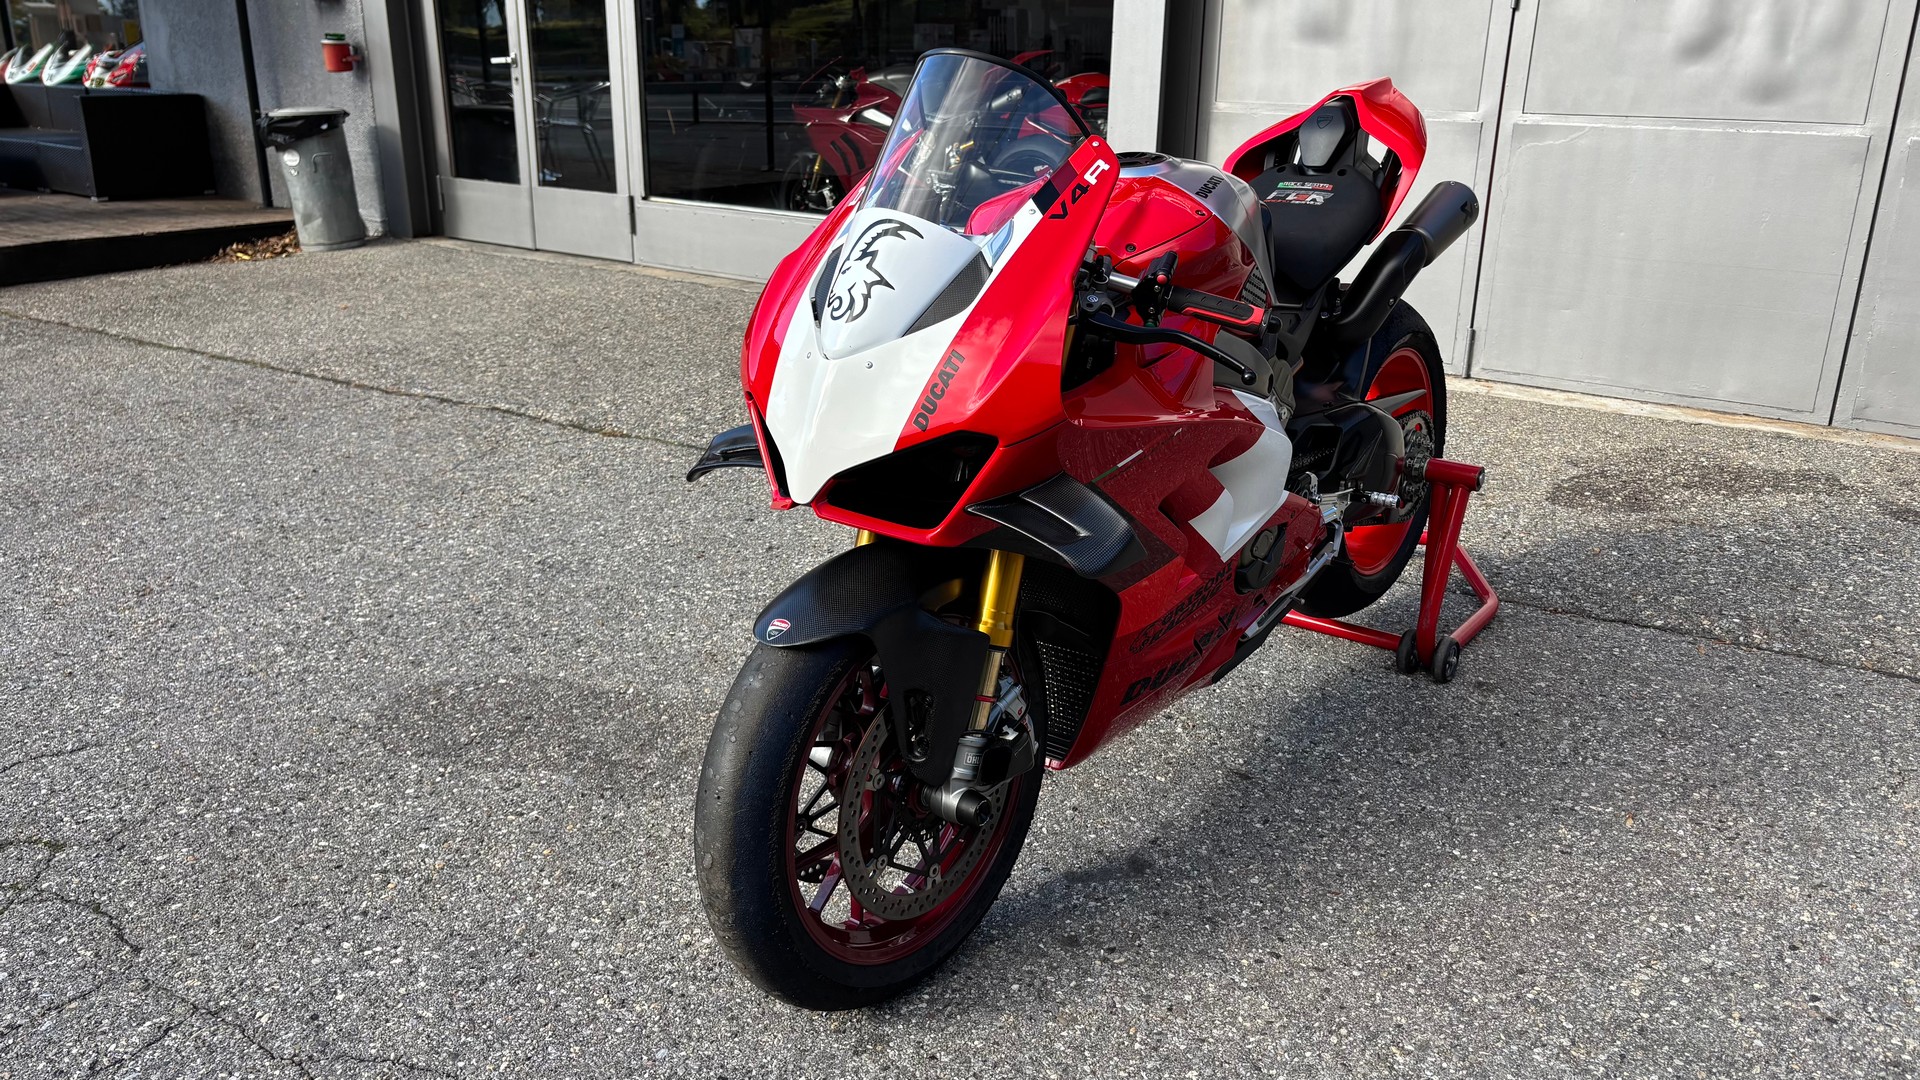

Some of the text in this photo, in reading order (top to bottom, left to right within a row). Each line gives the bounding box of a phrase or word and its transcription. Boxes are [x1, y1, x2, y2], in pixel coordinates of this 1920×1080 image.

[1048, 158, 1111, 220] V4R
[1194, 175, 1225, 199] DUCATI
[912, 348, 966, 433] DUCATI
